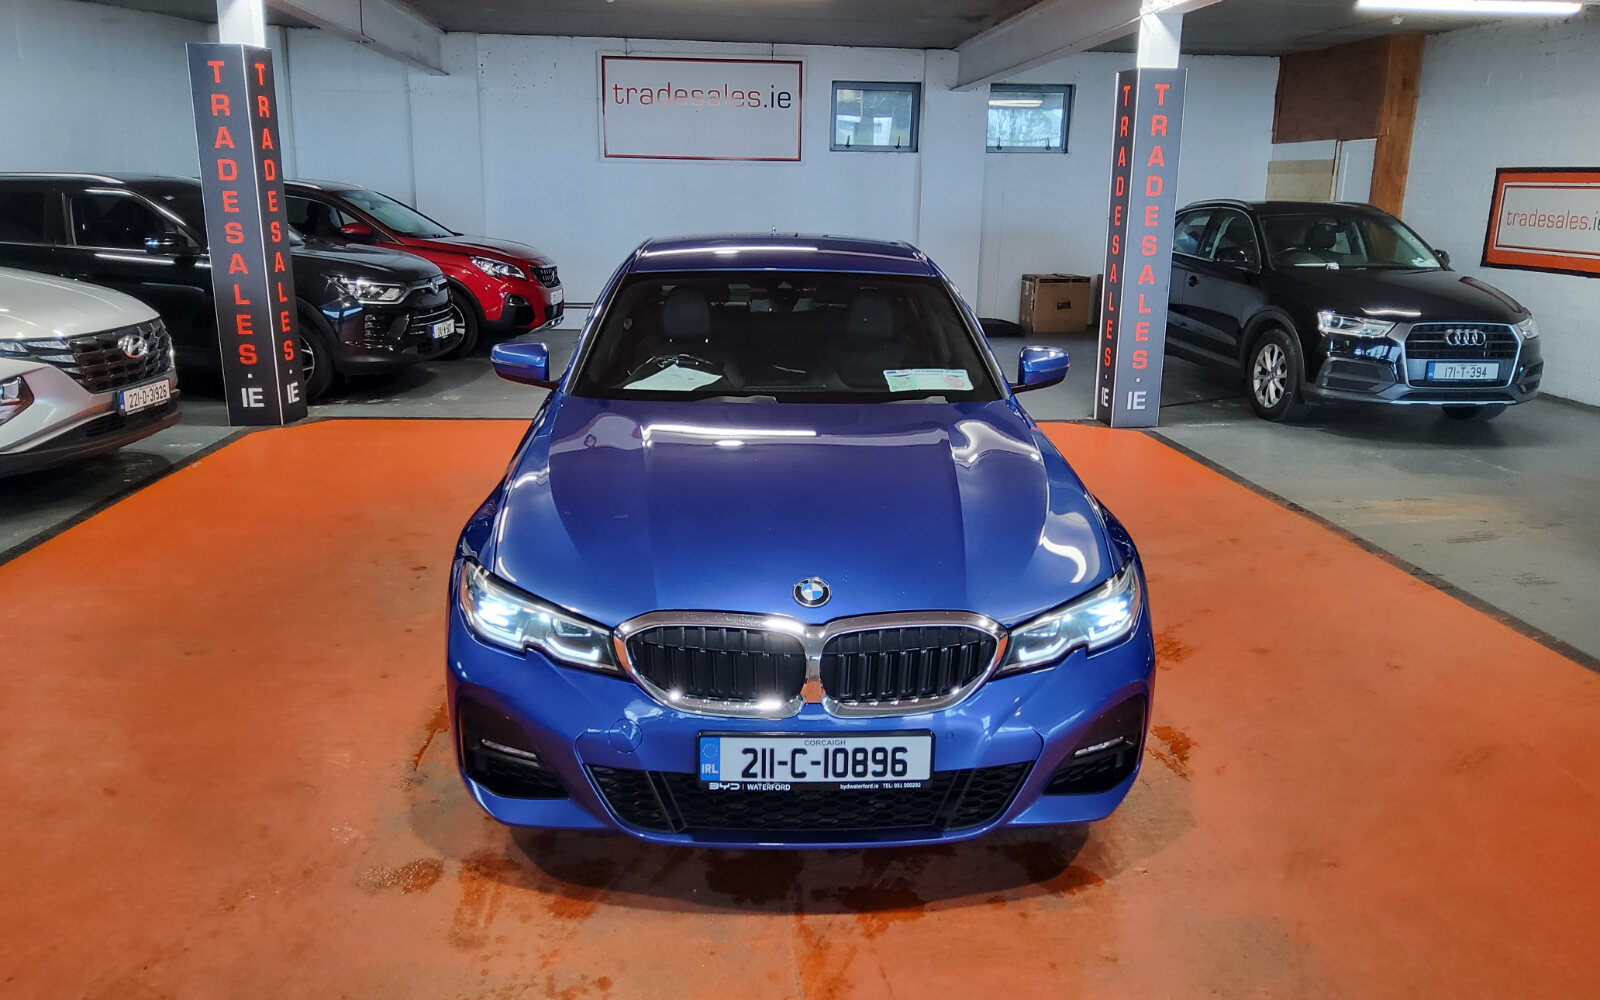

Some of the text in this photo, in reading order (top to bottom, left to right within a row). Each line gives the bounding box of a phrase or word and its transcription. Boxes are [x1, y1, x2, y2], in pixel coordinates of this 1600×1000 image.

[612, 81, 792, 109] tradesales.ie
[1506, 207, 1600, 231] tradesales.i
[1444, 366, 1487, 379] 171-T-394
[804, 739, 846, 747] CORCAIGH
[701, 763, 719, 774] IRL
[741, 746, 908, 779] 211-C-10896
[709, 782, 791, 791] BYD WATERFORD
